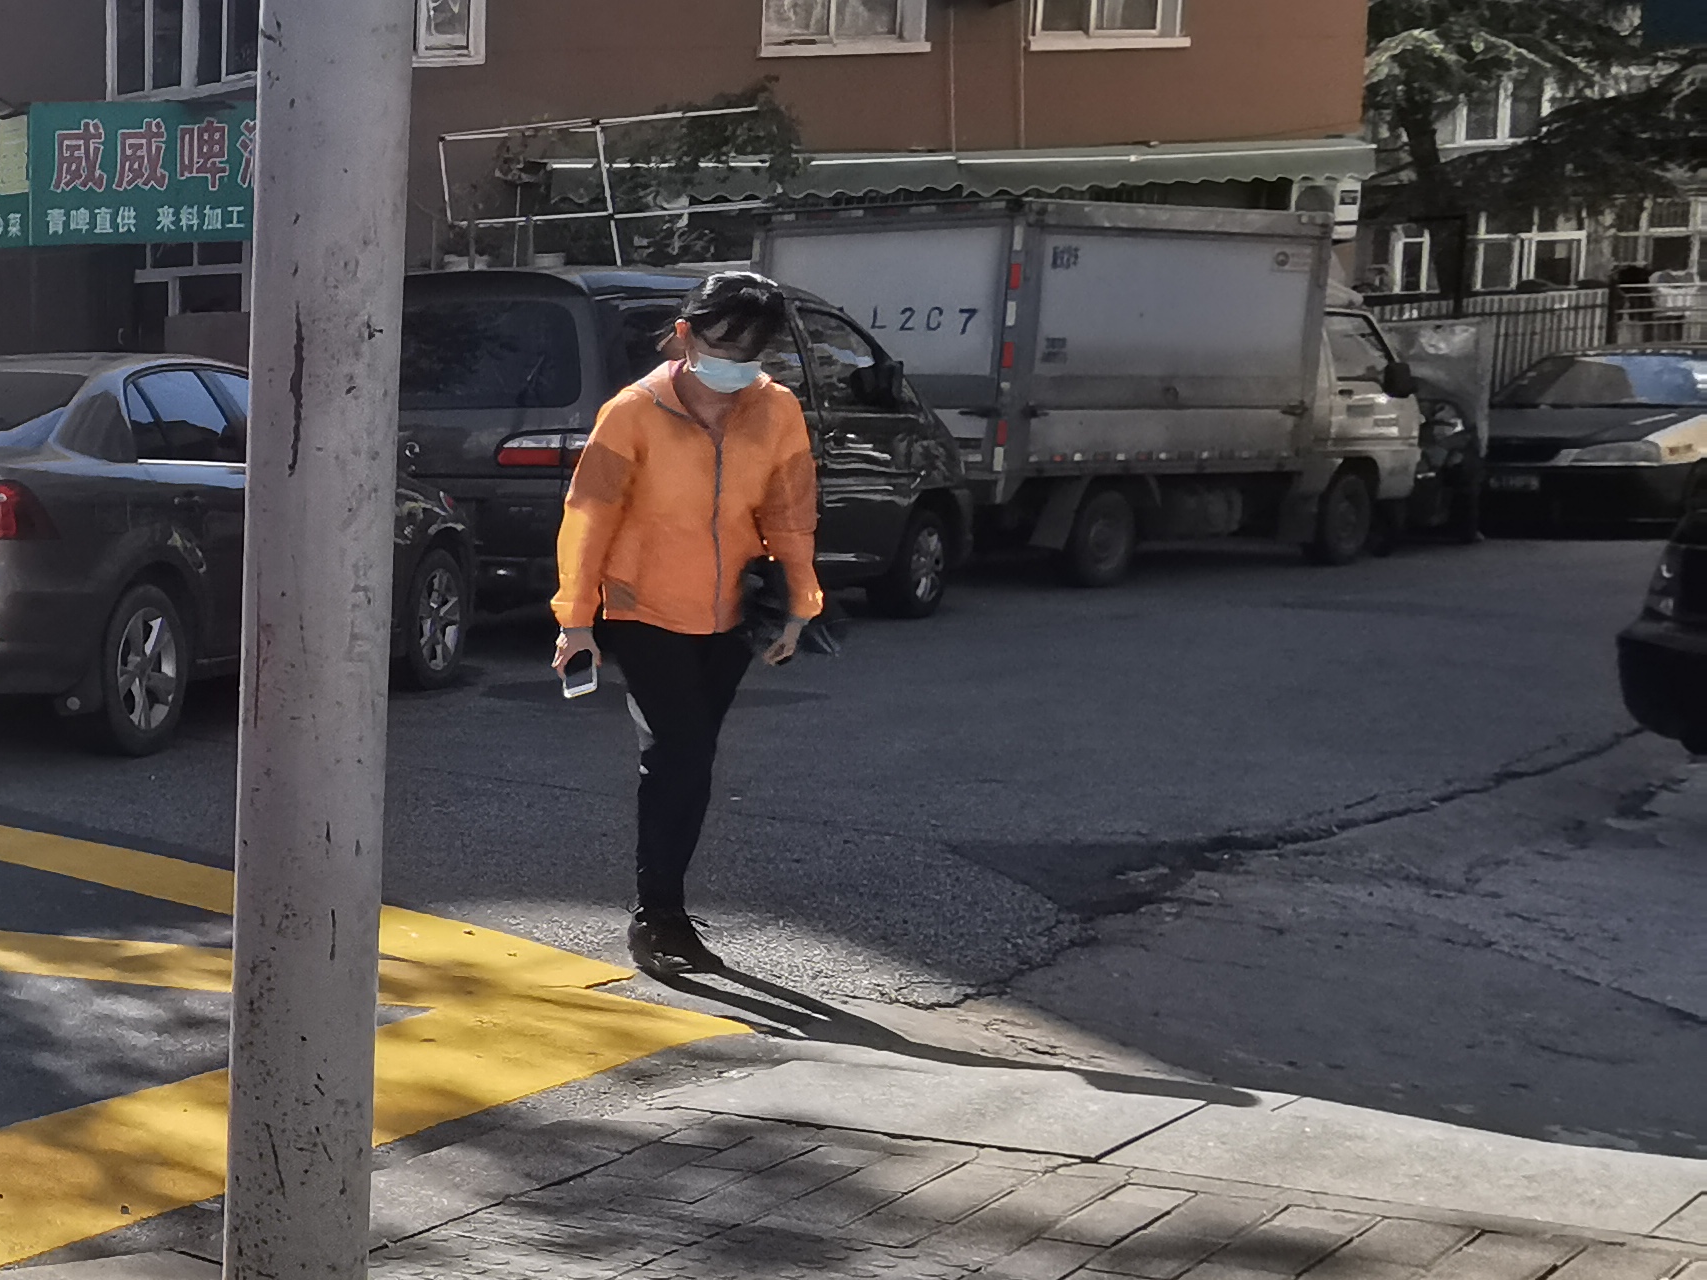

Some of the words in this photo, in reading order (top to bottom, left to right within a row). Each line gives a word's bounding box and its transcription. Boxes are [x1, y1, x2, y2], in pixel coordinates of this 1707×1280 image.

[46, 206, 137, 235] 青啤直供
[156, 204, 245, 233] 来料加工
